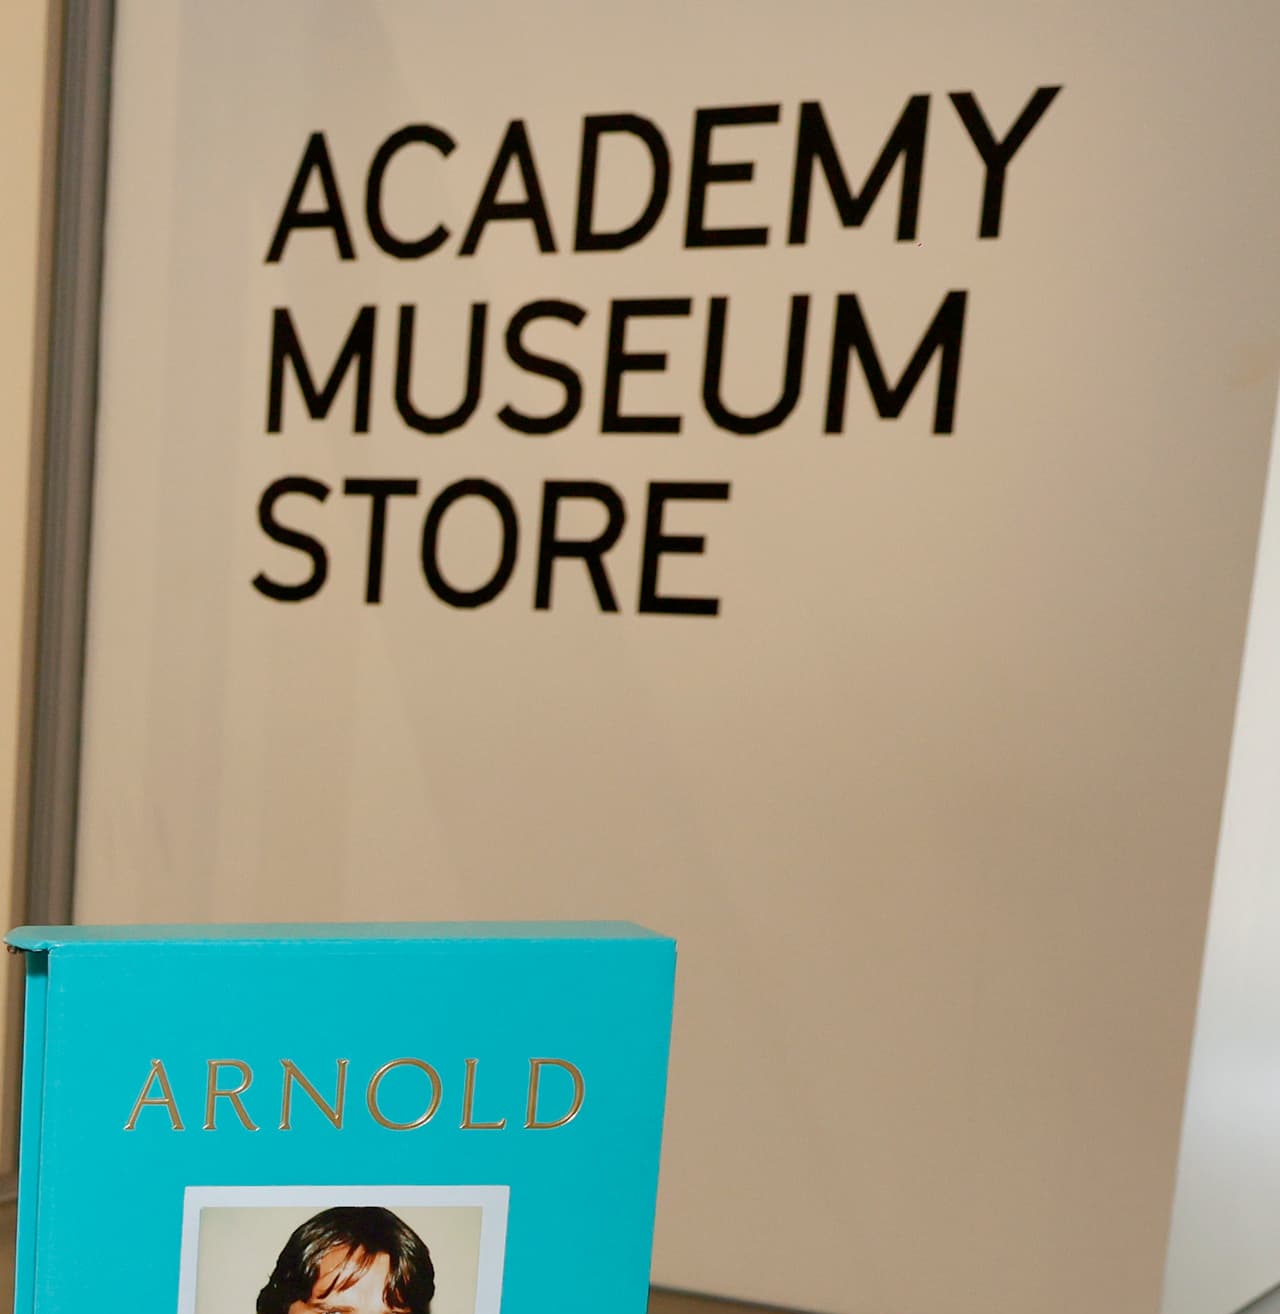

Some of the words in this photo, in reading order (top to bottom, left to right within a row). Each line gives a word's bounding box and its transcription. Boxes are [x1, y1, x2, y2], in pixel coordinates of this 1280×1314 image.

[263, 84, 1063, 265] ACADEMY
[265, 288, 969, 437] MUSEUM
[251, 475, 732, 617] STORE
[123, 1057, 586, 1132] ARNOLD
